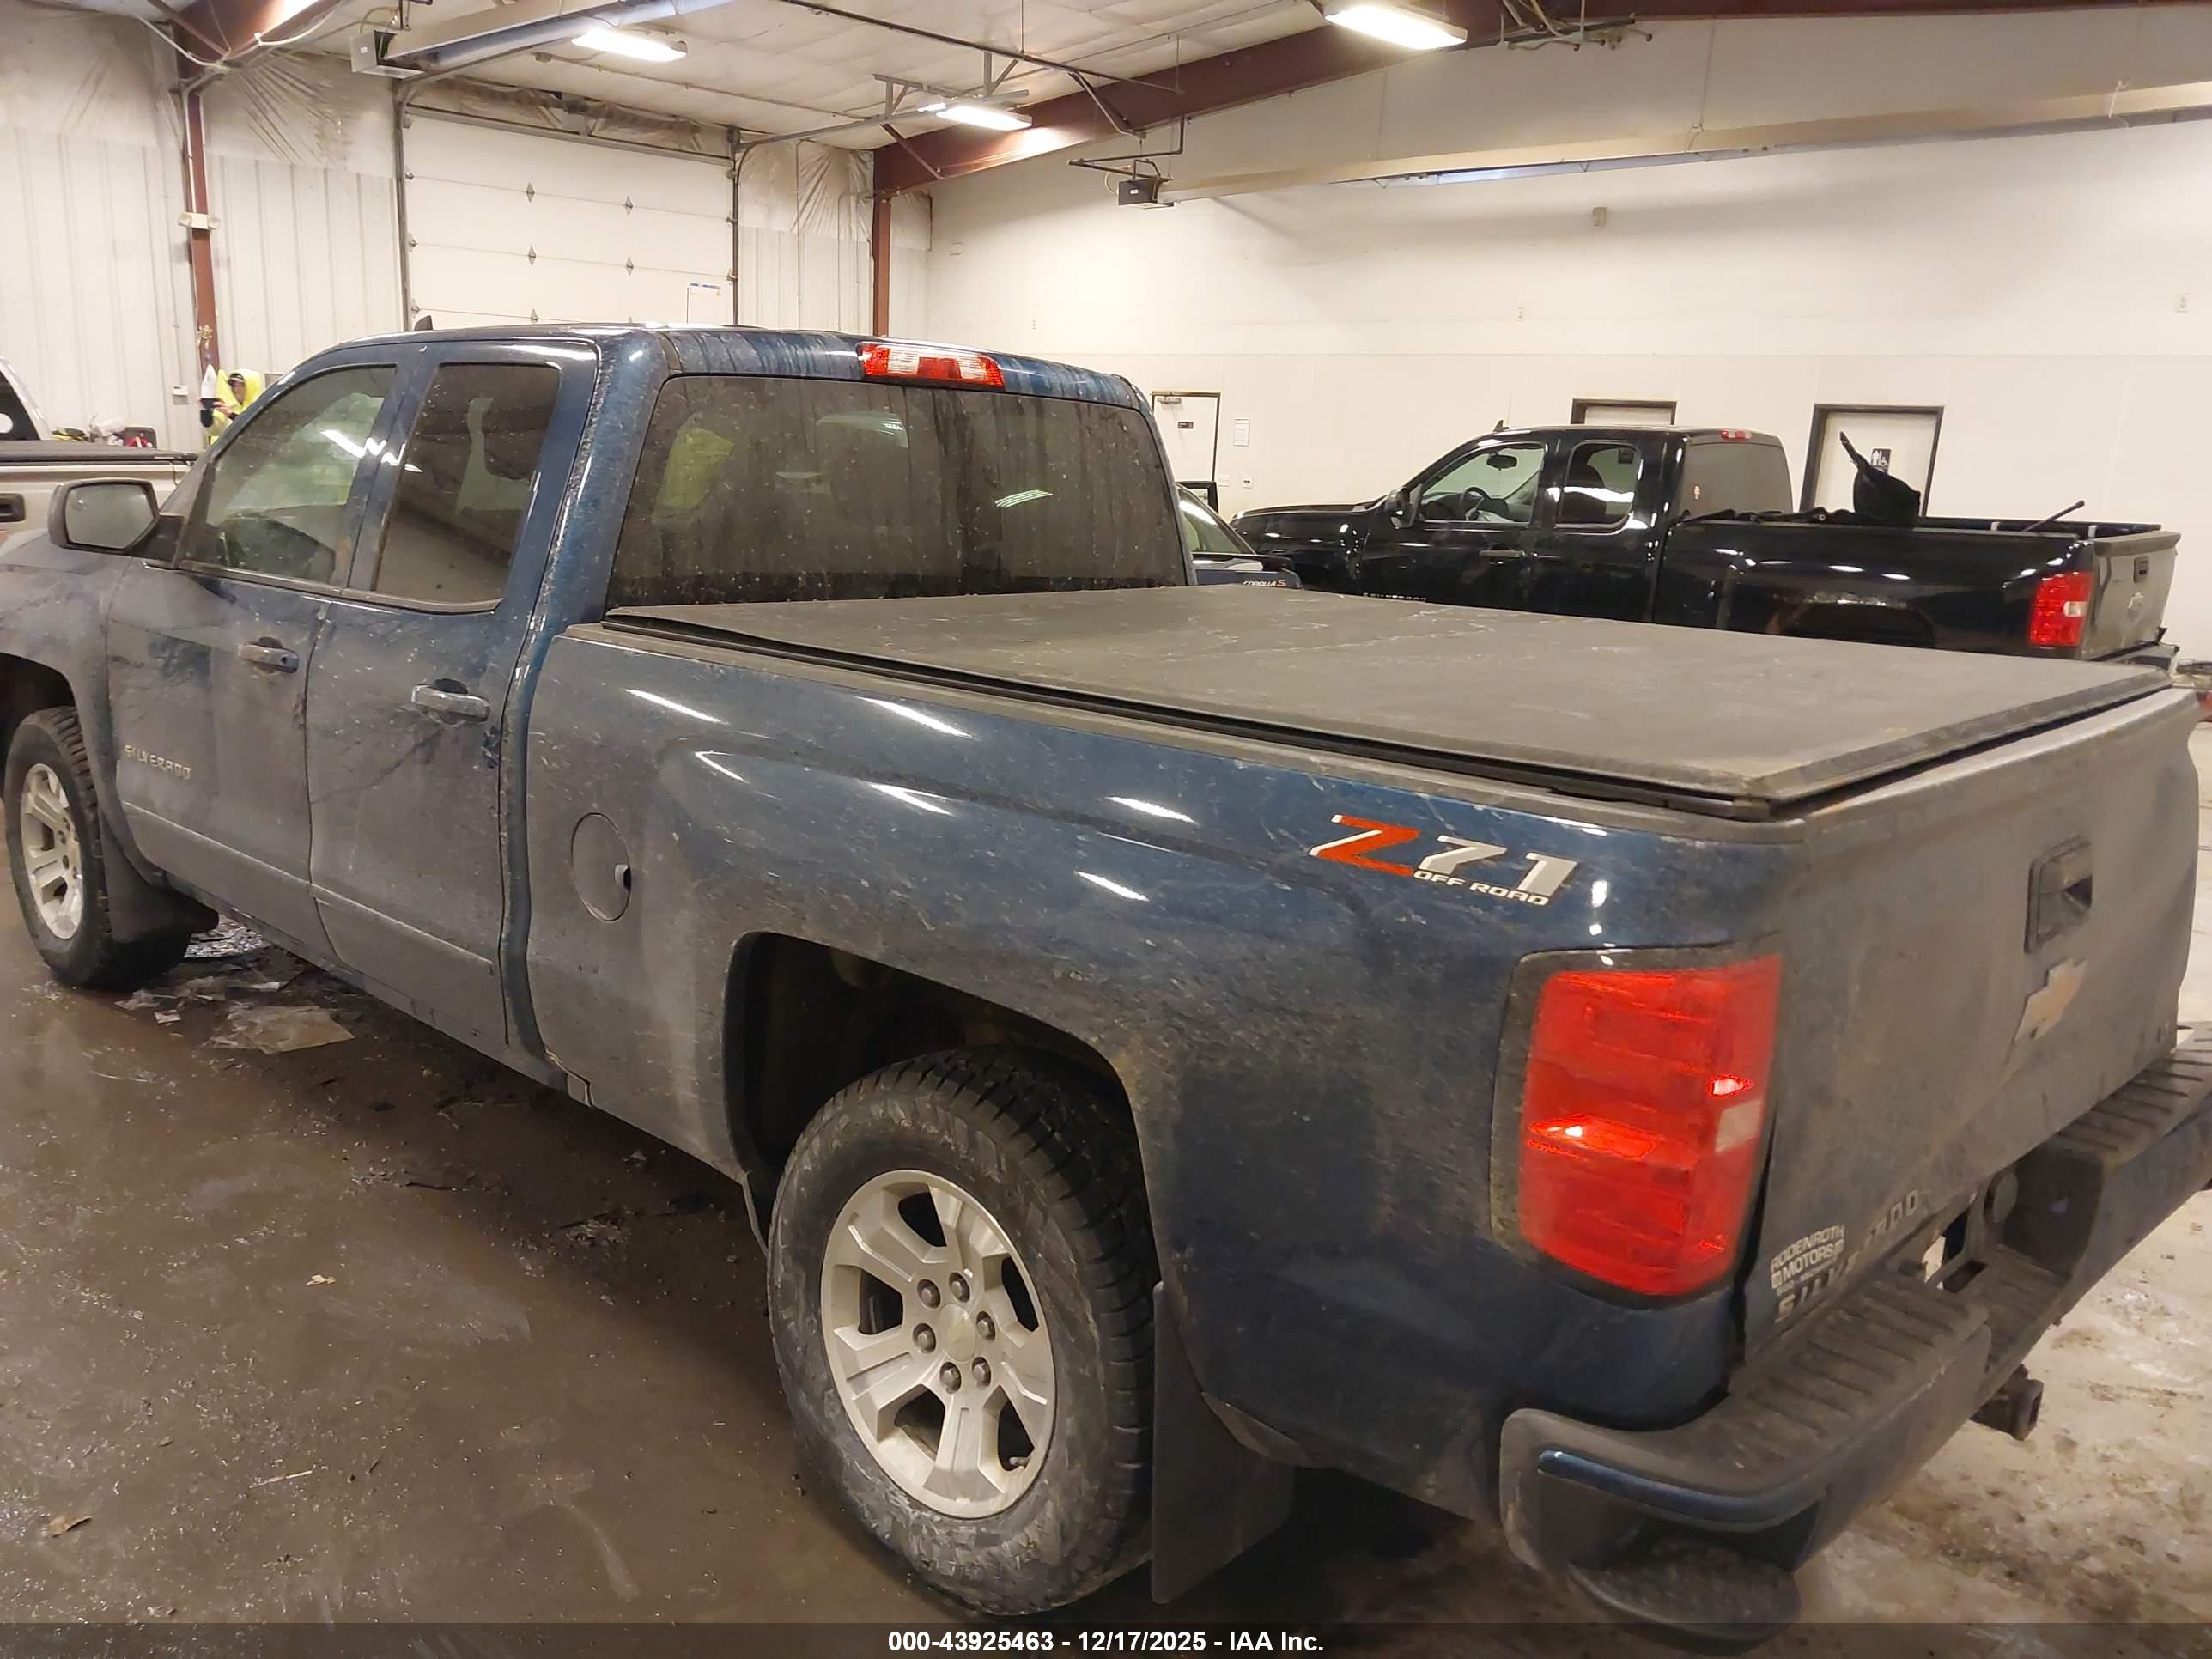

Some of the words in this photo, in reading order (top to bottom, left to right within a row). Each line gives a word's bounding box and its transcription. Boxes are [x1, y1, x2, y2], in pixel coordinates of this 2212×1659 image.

[124, 744, 192, 780] SILVERADO
[1309, 814, 1578, 897] Z71
[1413, 870, 1464, 887] OFF
[1469, 882, 1550, 907] ROAD
[1771, 1225, 1845, 1273] RODENROTH
[1782, 1243, 1835, 1282] MOTORS
